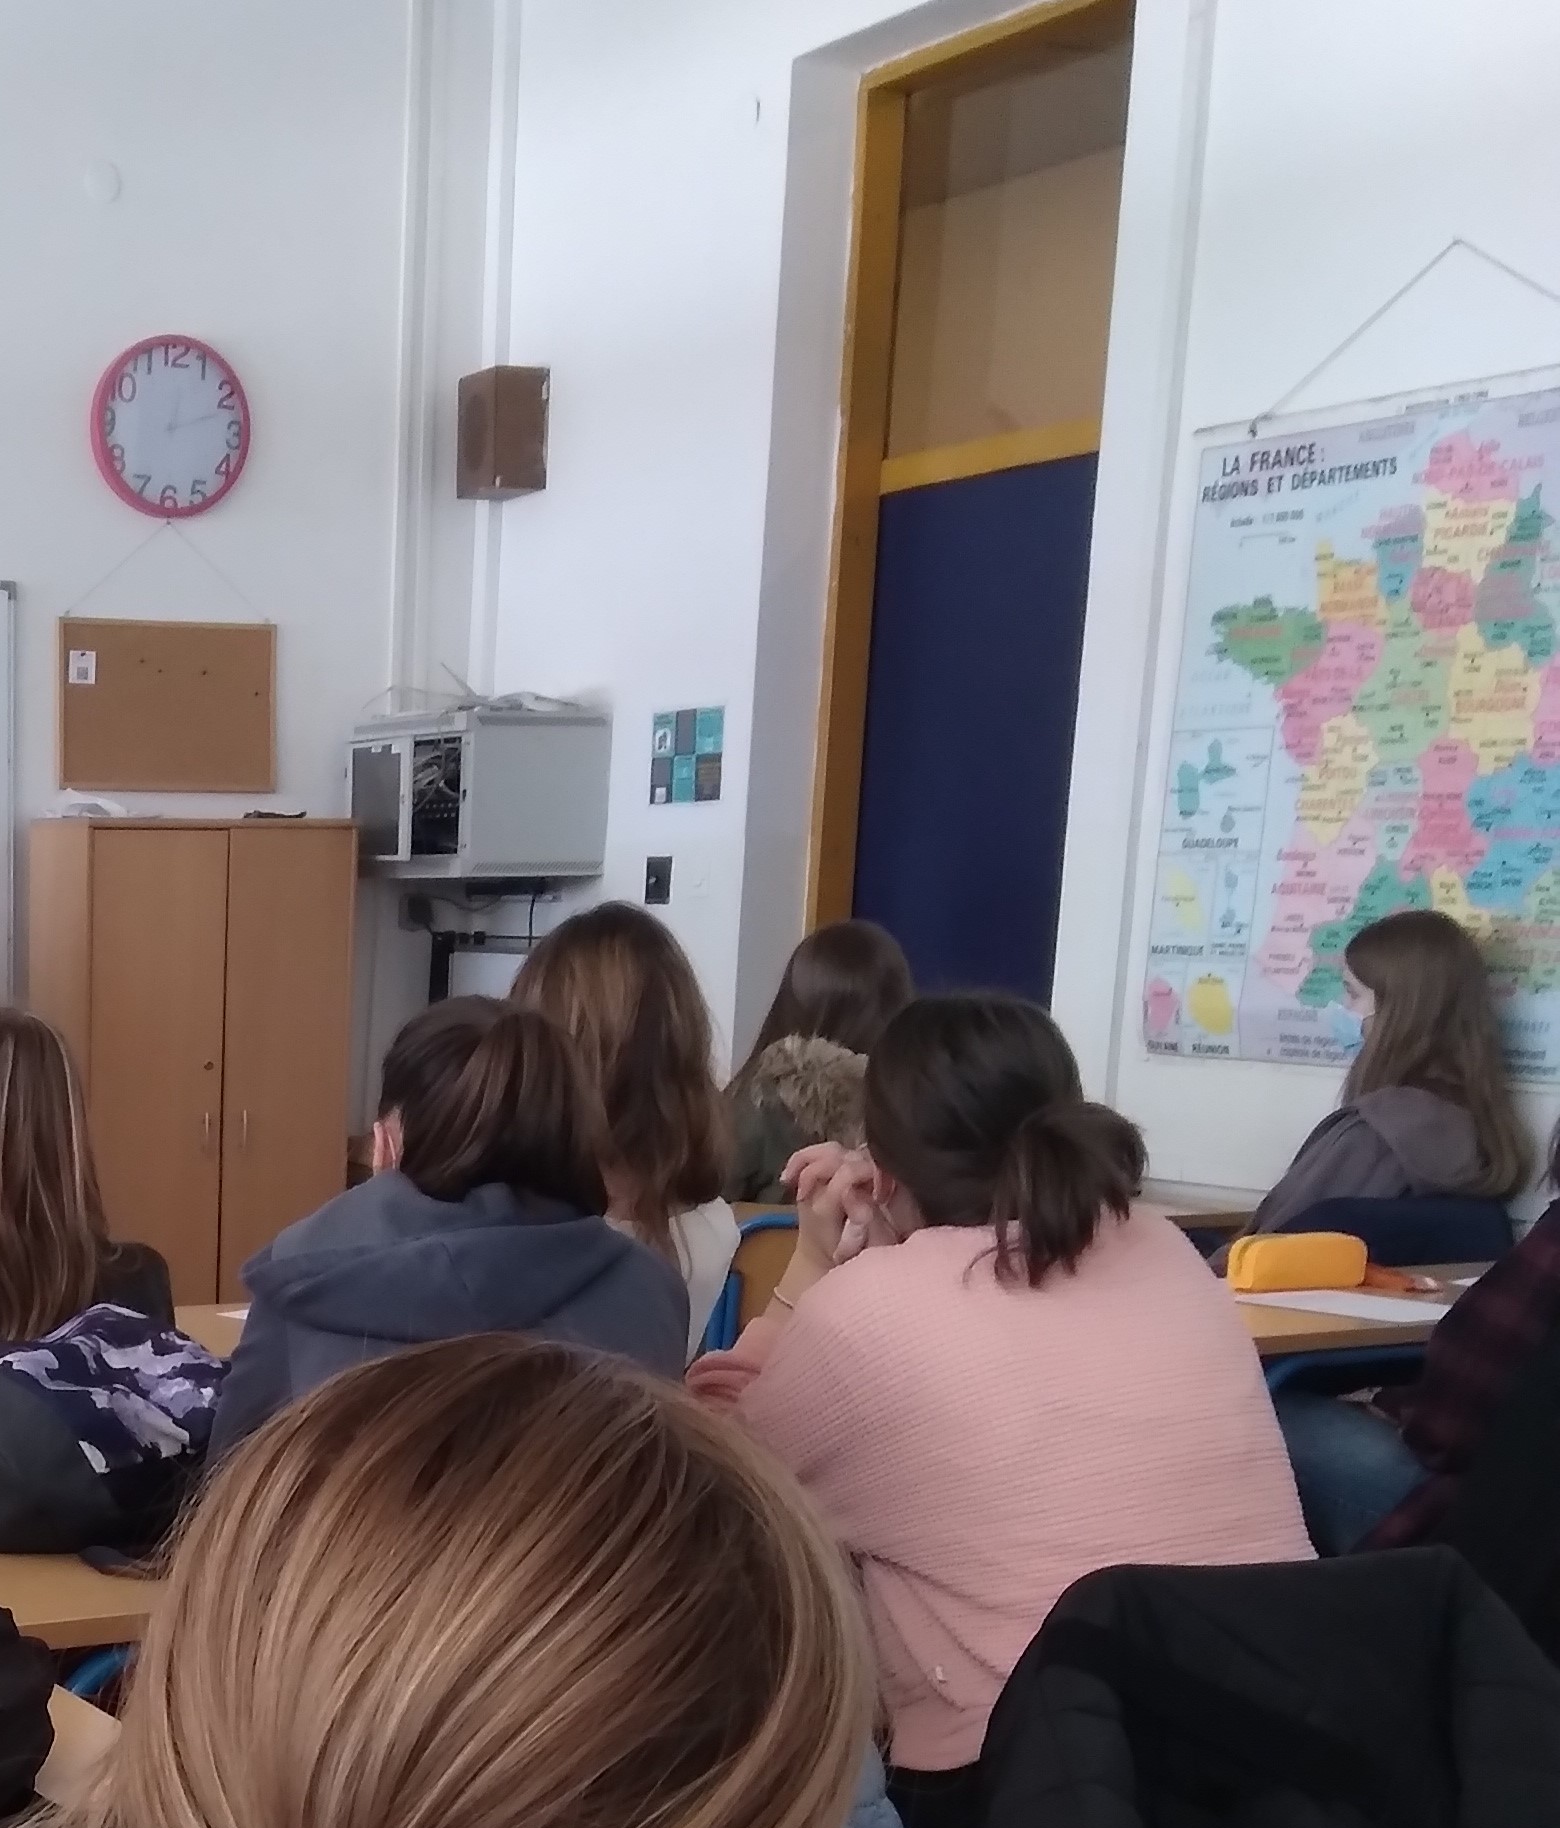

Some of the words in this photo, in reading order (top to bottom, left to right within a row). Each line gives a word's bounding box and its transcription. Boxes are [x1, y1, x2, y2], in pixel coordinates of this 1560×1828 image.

[161, 344, 191, 369] 12
[196, 351, 207, 381] 1
[217, 379, 236, 411] 2
[225, 420, 241, 450] 3
[214, 453, 233, 481] 4
[1202, 478, 1259, 503] RÉGIONS
[1267, 475, 1285, 494] ET
[1291, 456, 1398, 491] DÉPARTEMENTS
[1222, 455, 1240, 477] LA
[132, 473, 153, 495] 7
[159, 484, 180, 509] 6
[190, 479, 208, 506] 5
